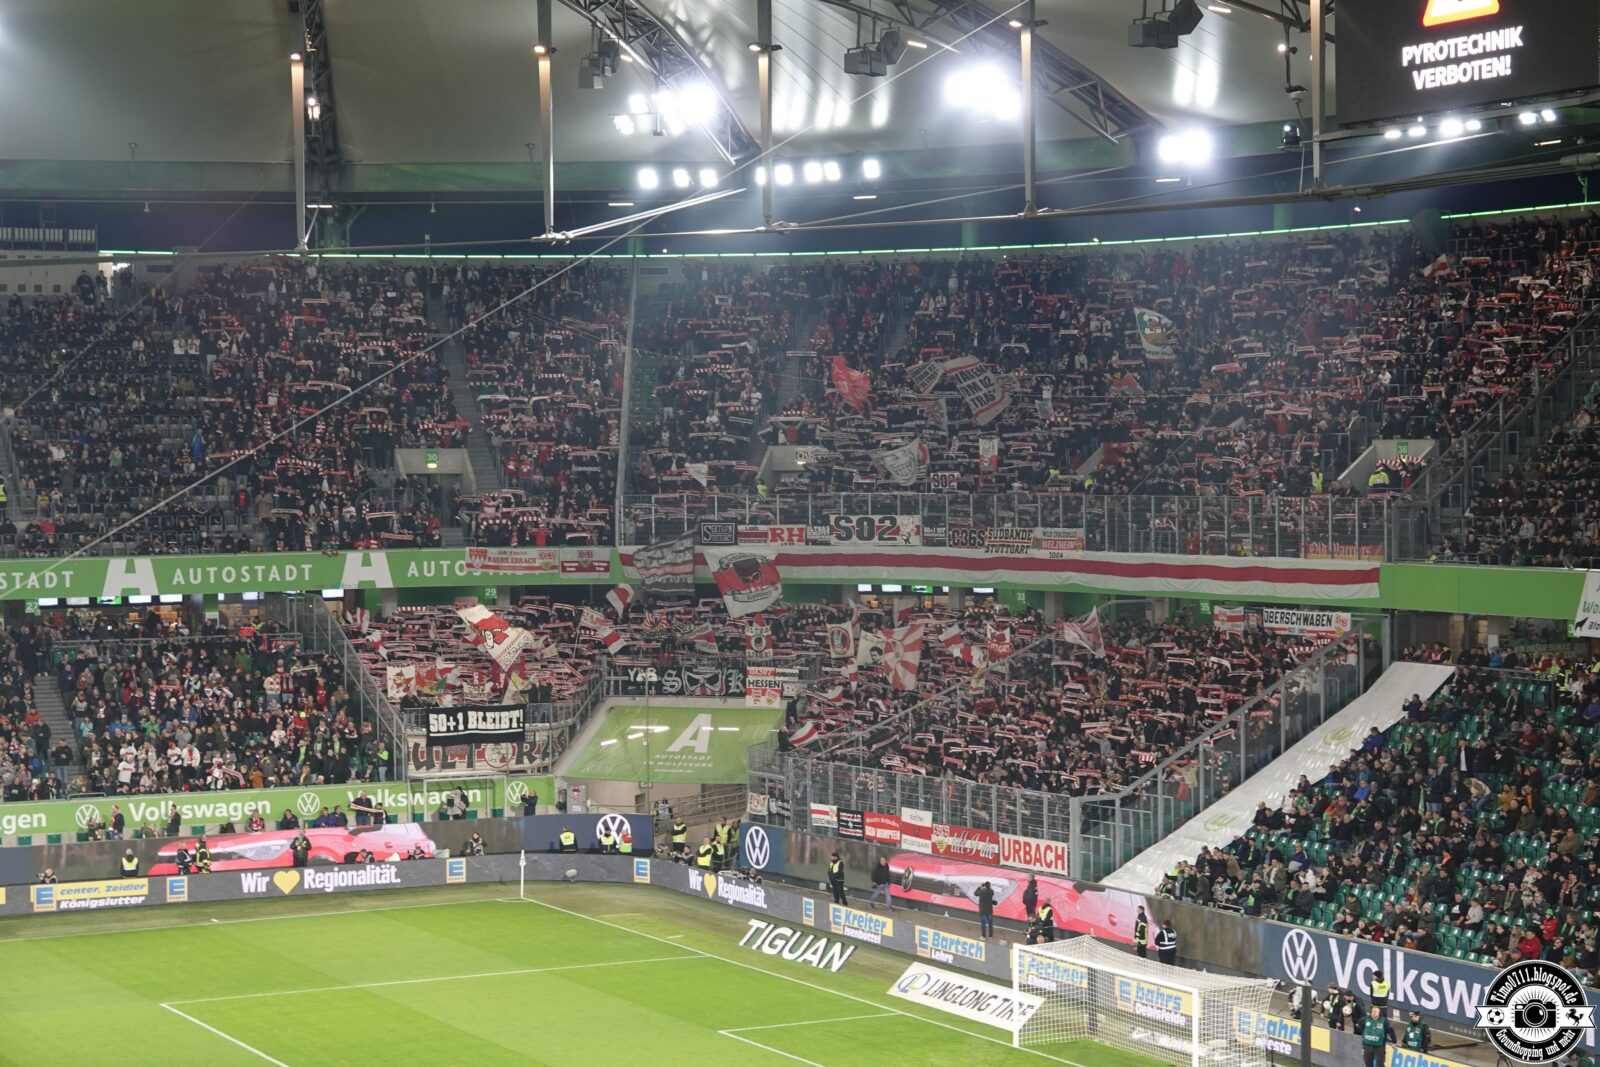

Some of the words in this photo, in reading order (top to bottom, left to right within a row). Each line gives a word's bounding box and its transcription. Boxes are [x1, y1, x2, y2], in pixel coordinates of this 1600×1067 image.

[1402, 26, 1523, 67] PYROTECHNIK
[1412, 55, 1512, 90] VERBOTEN!
[426, 453, 438, 461] 30
[769, 527, 805, 542] RH
[171, 564, 314, 585] AUTOSTADT
[485, 588, 497, 596] 29
[1017, 593, 1025, 601] 33
[26, 602, 39, 611] 27
[1200, 602, 1210, 611] 35
[1264, 610, 1333, 627] OBERSCHWABEN
[748, 679, 780, 688] HESSEN
[429, 712, 465, 733] 50+1
[467, 709, 524, 730] BLEIBT!
[0, 812, 47, 835] gen
[1001, 837, 1066, 871] URBACH
[241, 871, 269, 893] Wir
[303, 864, 401, 892] Regionalität.
[688, 868, 702, 892] Wir
[59, 896, 146, 910] Königslutter
[844, 909, 887, 934] Kreiter
[738, 918, 856, 973] TIGUAN
[931, 931, 983, 959] Bartsch
[931, 948, 954, 964] Lehre
[922, 979, 998, 1012] LINGLONG
